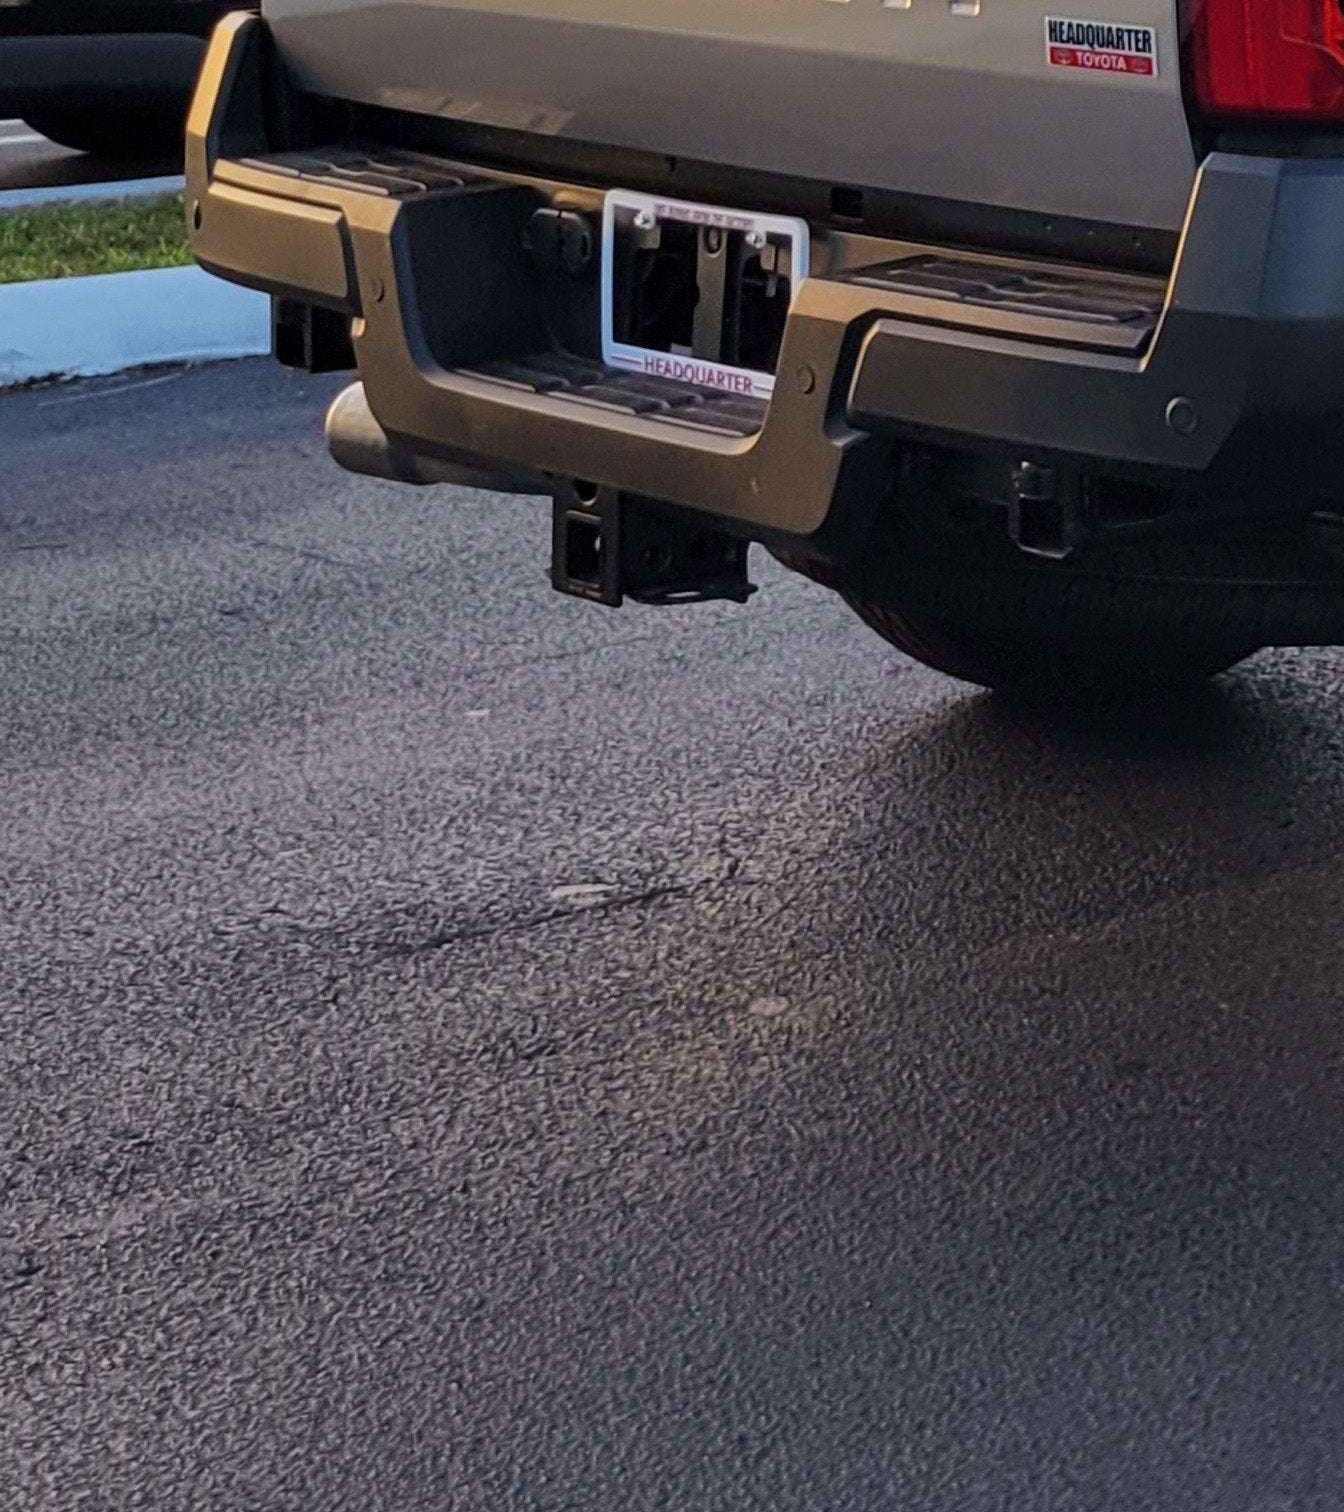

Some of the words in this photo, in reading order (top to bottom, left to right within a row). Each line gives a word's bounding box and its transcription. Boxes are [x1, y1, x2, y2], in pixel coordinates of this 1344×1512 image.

[1047, 19, 1153, 53] HEADQUARTER
[1076, 51, 1128, 70] TOYOTA
[643, 356, 753, 393] HEADQUARTER
